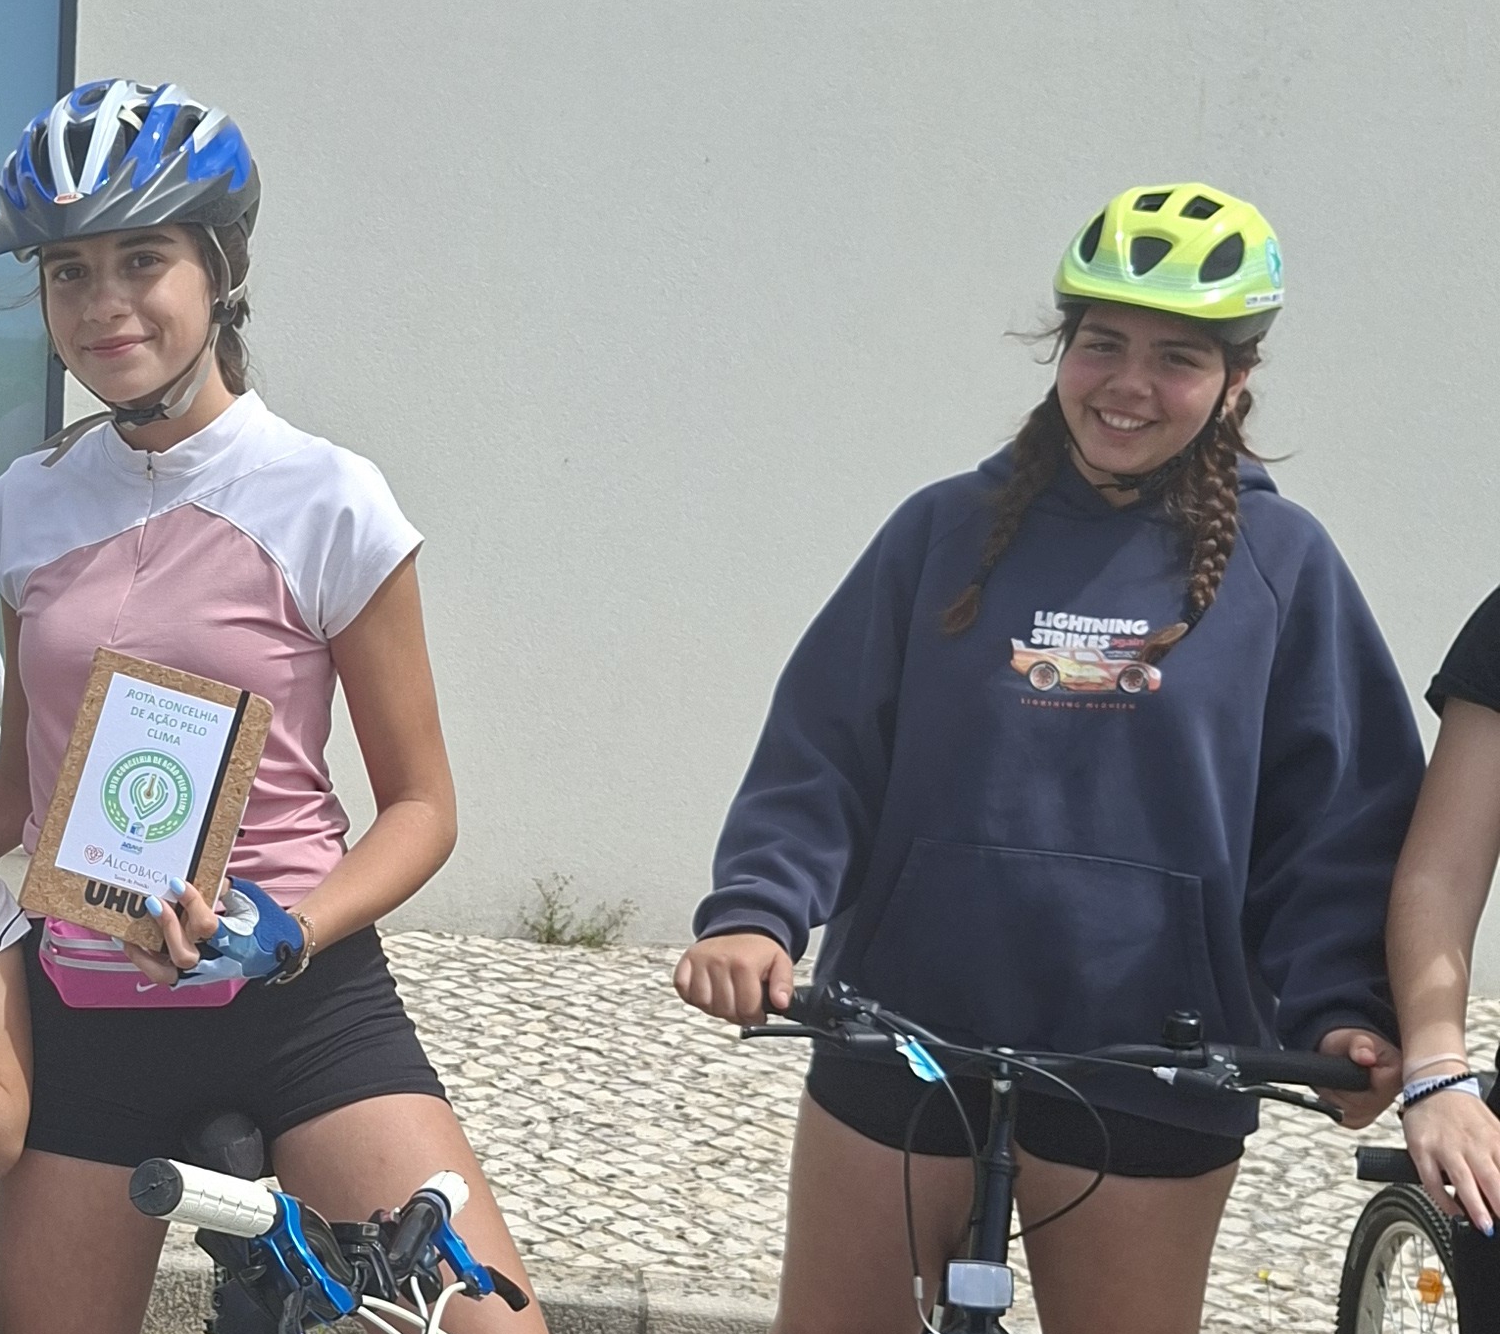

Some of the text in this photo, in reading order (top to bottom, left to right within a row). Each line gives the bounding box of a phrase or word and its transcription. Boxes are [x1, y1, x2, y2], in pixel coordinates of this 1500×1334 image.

[1034, 611, 1149, 635] LIGHTNING
[1030, 628, 1110, 650] STRIKES
[127, 688, 219, 724] ROTA CONCELHIA
[130, 706, 207, 737] DE AÇÃO PELO
[147, 728, 181, 746] CLIMA
[102, 853, 168, 884] ALCOBAÇA
[85, 880, 148, 918] UHU
